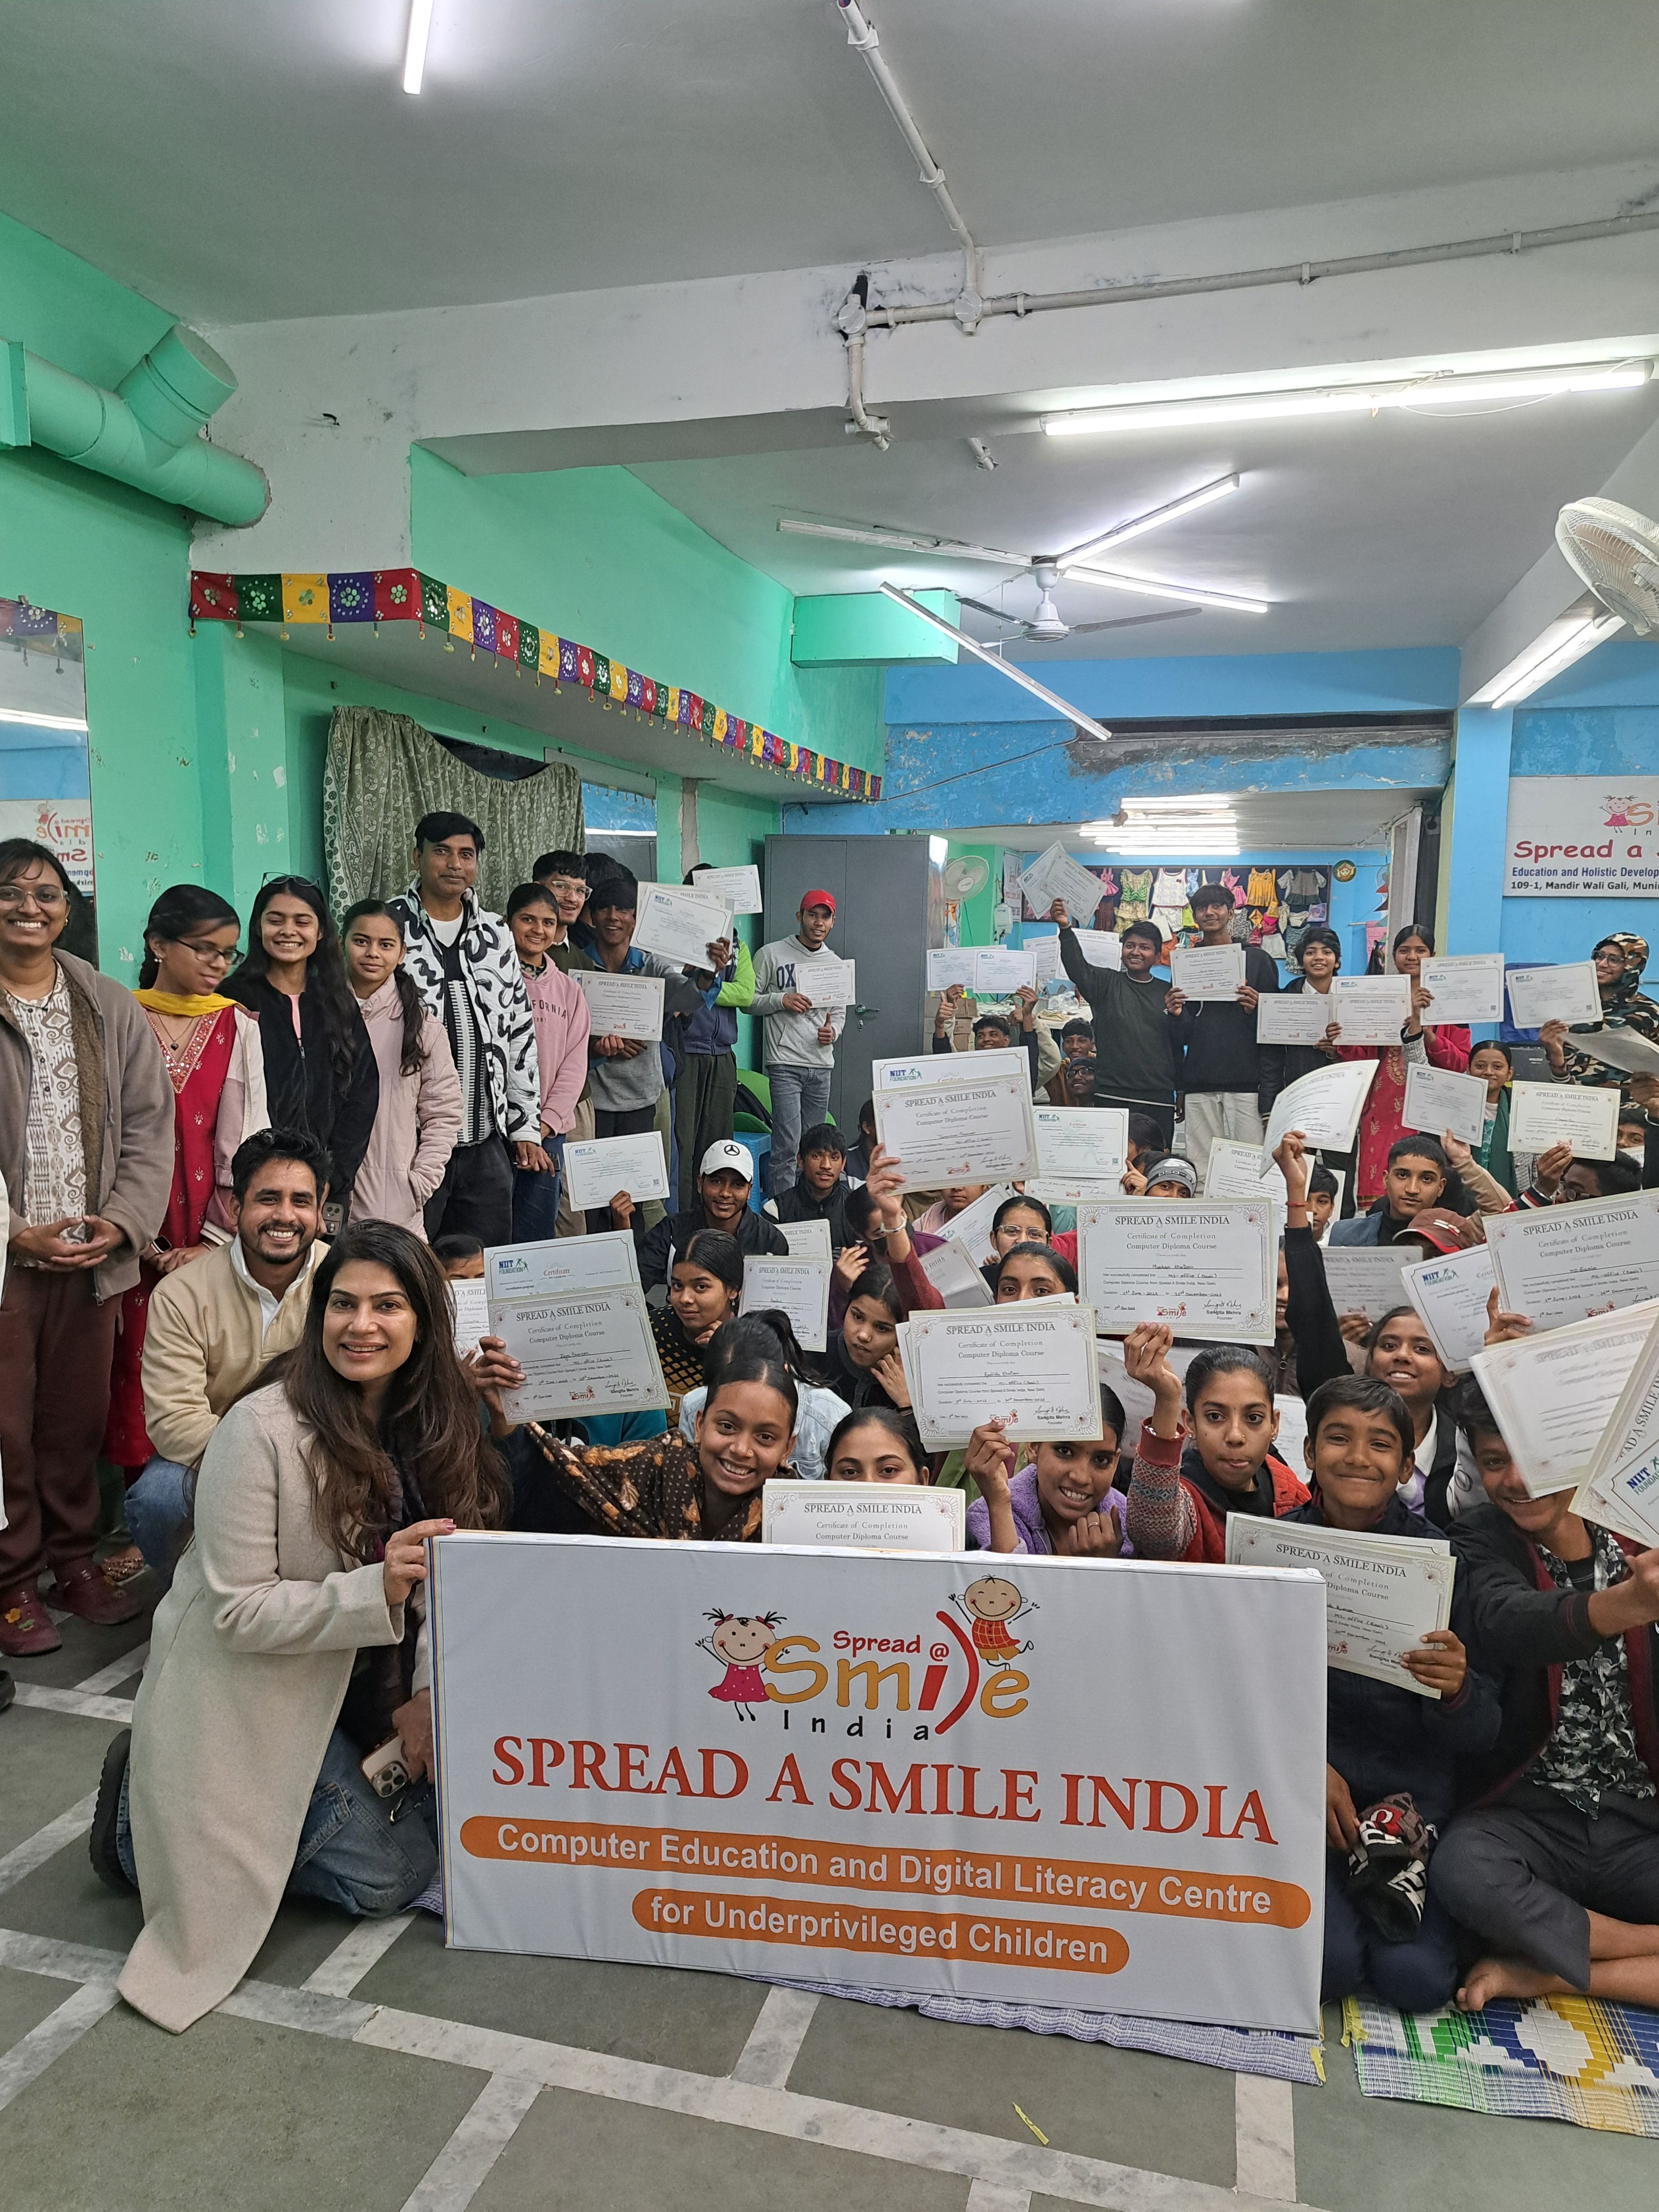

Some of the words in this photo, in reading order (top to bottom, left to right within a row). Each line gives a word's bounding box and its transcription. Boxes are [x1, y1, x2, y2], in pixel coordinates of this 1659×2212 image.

[1514, 839, 1613, 863] Spread
[1627, 845, 1642, 858] a
[1513, 867, 1558, 876] Education
[1561, 867, 1578, 876] and
[1582, 867, 1617, 876] Holistic
[1511, 882, 1542, 891] 109-1,
[1607, 882, 1629, 891] Gali,
[776, 963, 796, 990] OX
[532, 999, 566, 1019] FORNIA
[905, 1098, 936, 1107] SPREAD
[945, 1094, 970, 1103] SMILE
[972, 1090, 996, 1099] INDIA
[1231, 1150, 1251, 1158] SPREAD
[1115, 1217, 1153, 1226] SPREAD
[1165, 1217, 1197, 1225] SMILE
[1199, 1216, 1230, 1225] INDIA
[1523, 1223, 1562, 1236] SPREAD
[1564, 1222, 1571, 1230] A
[1573, 1217, 1605, 1228] SMILE
[1607, 1210, 1638, 1223] INDIA
[1171, 1232, 1216, 1241] Completion
[1538, 1238, 1569, 1248] Certificate
[1582, 1230, 1628, 1242] Completion
[1540, 1248, 1573, 1258] Computer
[1575, 1244, 1604, 1253] Diploma
[499, 1260, 513, 1269] NIIT
[499, 1266, 524, 1274] FOUNDATION
[1422, 1271, 1439, 1282] NIIT
[1424, 1274, 1453, 1287] FOUNDATION
[516, 1311, 548, 1322] SPREAD
[550, 1311, 556, 1319] A
[557, 1306, 584, 1317] SMILE
[585, 1303, 611, 1313] INDIA
[528, 1326, 554, 1335] Certificate
[564, 1320, 602, 1331] Completion
[946, 1326, 983, 1335] SPREAD
[994, 1324, 1025, 1333] SMILE
[1027, 1323, 1056, 1332] INDIA
[529, 1335, 557, 1344] Computer
[559, 1333, 583, 1341] Diploma
[1636, 1390, 1659, 1427] SMILE
[1626, 1467, 1651, 1490] NIIT
[804, 1504, 845, 1514] SPREAD
[847, 1504, 854, 1514] A
[856, 1504, 889, 1514] SMILE
[891, 1505, 922, 1514] INDIA
[817, 1521, 849, 1529] Certificate
[862, 1522, 908, 1531] Completion
[816, 1533, 851, 1541] Computer
[853, 1533, 882, 1541] Diploma
[1275, 1544, 1320, 1561] SPREAD
[1322, 1554, 1331, 1563] A
[1333, 1556, 1370, 1571] SMILE
[1372, 1563, 1406, 1578] INDIA
[1338, 1573, 1389, 1590] Completion
[1327, 1581, 1360, 1595] Diploma
[1361, 1589, 1389, 1601] Course
[833, 1630, 921, 1658] Spread
[929, 1642, 950, 1661] @
[764, 1611, 1030, 1735] Smile
[784, 1710, 930, 1741] India
[492, 1735, 749, 1800] SPREAD
[765, 1752, 814, 1806] A
[829, 1758, 1041, 1822] SMILE
[1060, 1773, 1278, 1846] INDIA
[498, 1824, 651, 1862] Computer
[660, 1834, 818, 1876] Education
[829, 1854, 888, 1882] and
[900, 1854, 1002, 1891] Digital
[1014, 1864, 1148, 1910] Literacy
[1158, 1875, 1272, 1914] Centre
[651, 1896, 695, 1927] for
[706, 1900, 957, 1954] Underprivileged
[969, 1923, 1107, 1964] Children
